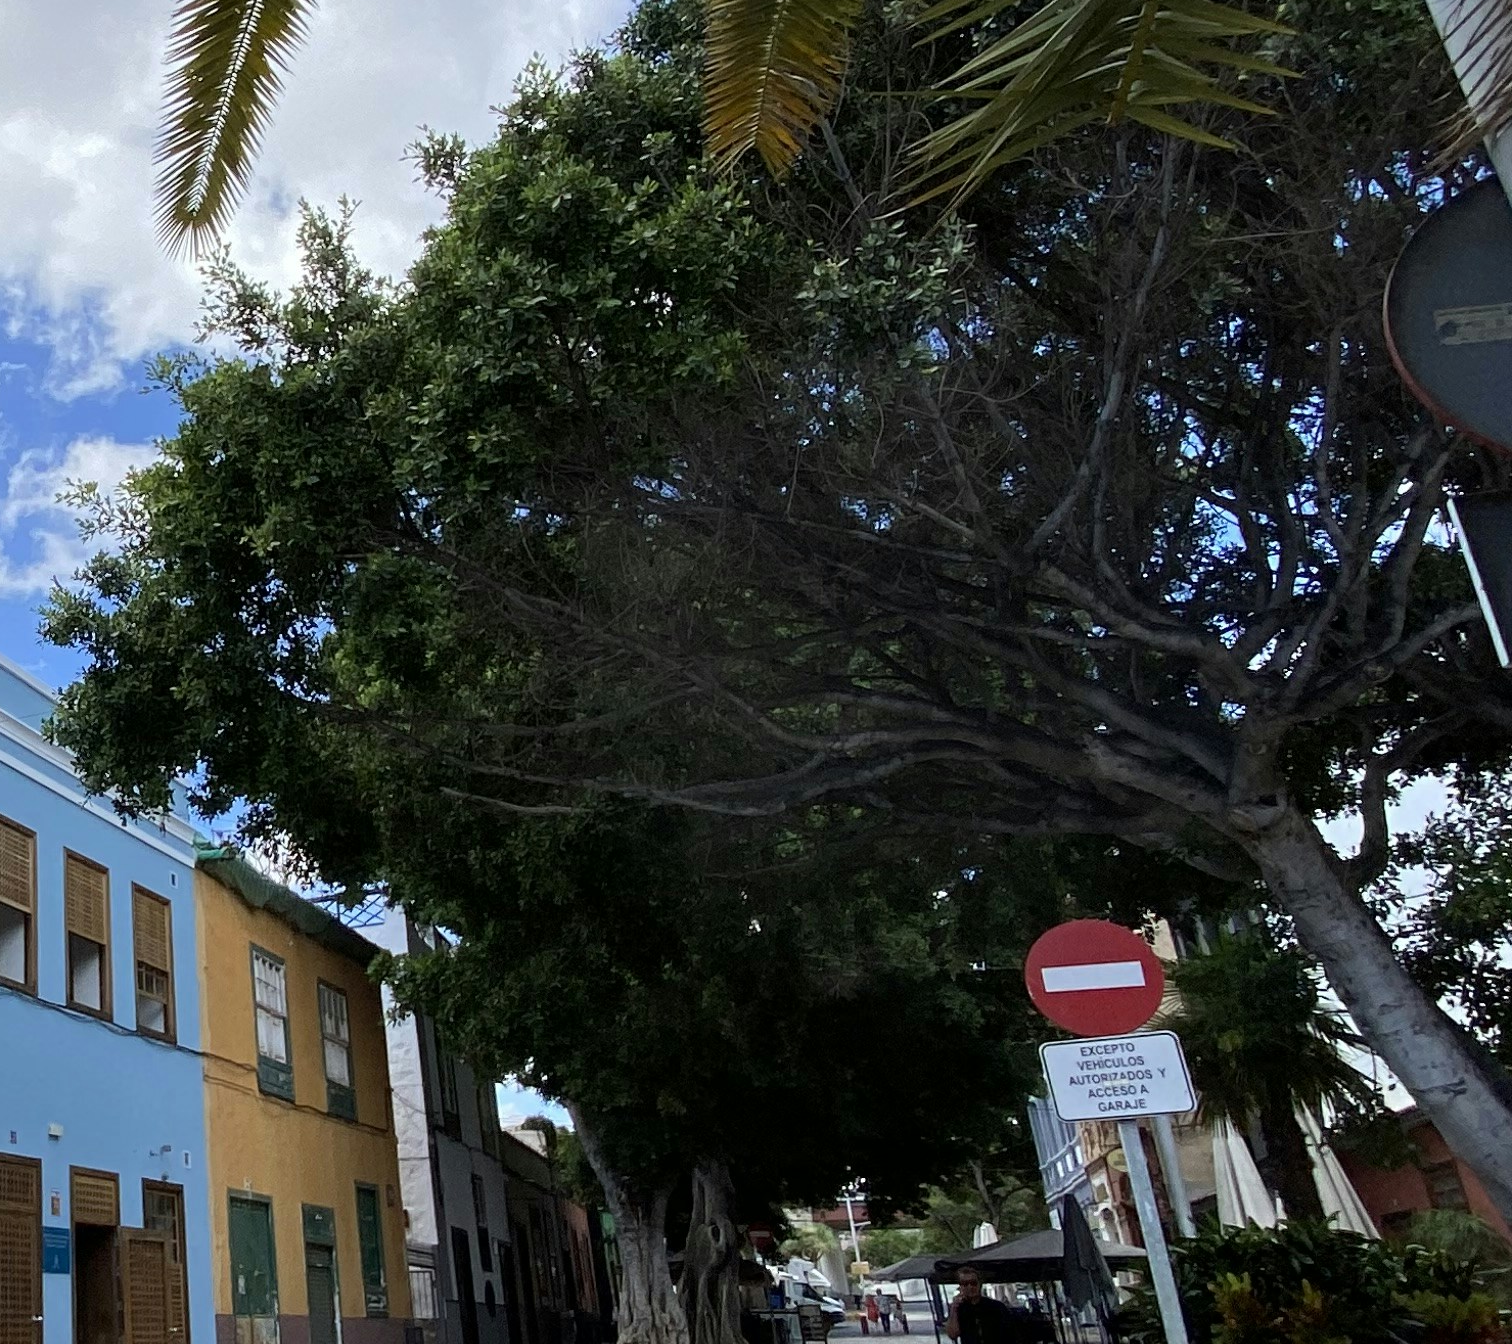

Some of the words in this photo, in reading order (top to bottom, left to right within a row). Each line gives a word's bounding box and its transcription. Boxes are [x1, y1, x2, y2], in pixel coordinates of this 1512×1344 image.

[1080, 1043, 1135, 1057] EXCEPTO
[1076, 1056, 1145, 1071] VEHÍCULOS
[1069, 1069, 1153, 1086] AUTORIZADOS
[1157, 1068, 1166, 1078] Y
[1088, 1085, 1137, 1098] ACCESO
[1140, 1084, 1149, 1094] A
[1098, 1098, 1147, 1112] GARAJE
